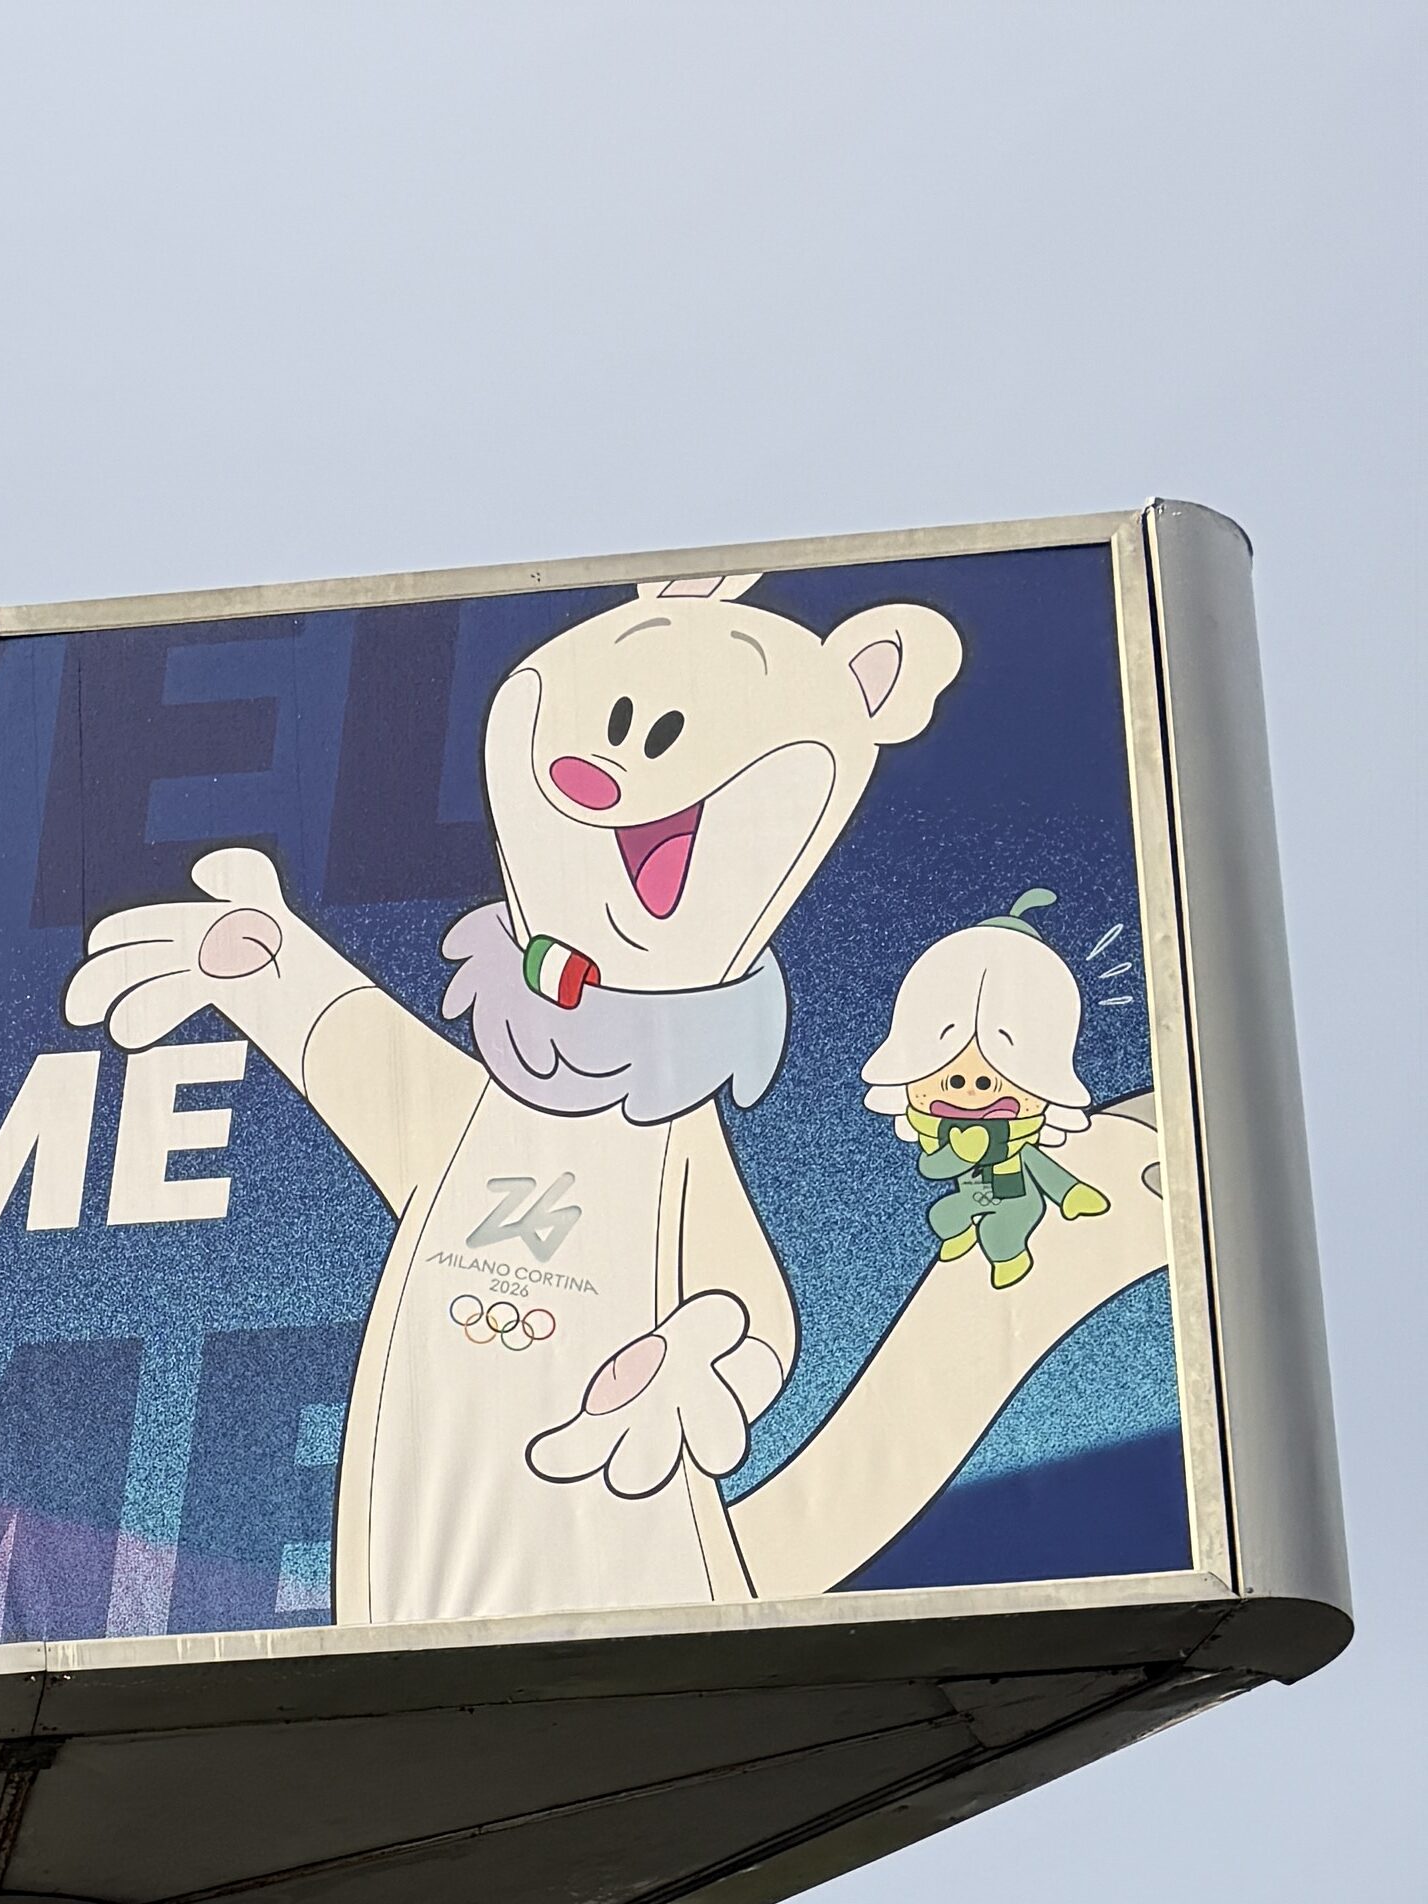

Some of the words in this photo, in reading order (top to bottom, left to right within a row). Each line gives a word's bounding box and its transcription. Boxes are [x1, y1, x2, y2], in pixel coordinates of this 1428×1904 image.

[425, 1251, 511, 1277] MILANO
[514, 1266, 599, 1296] CORTINA
[488, 1278, 530, 1298] 2026
